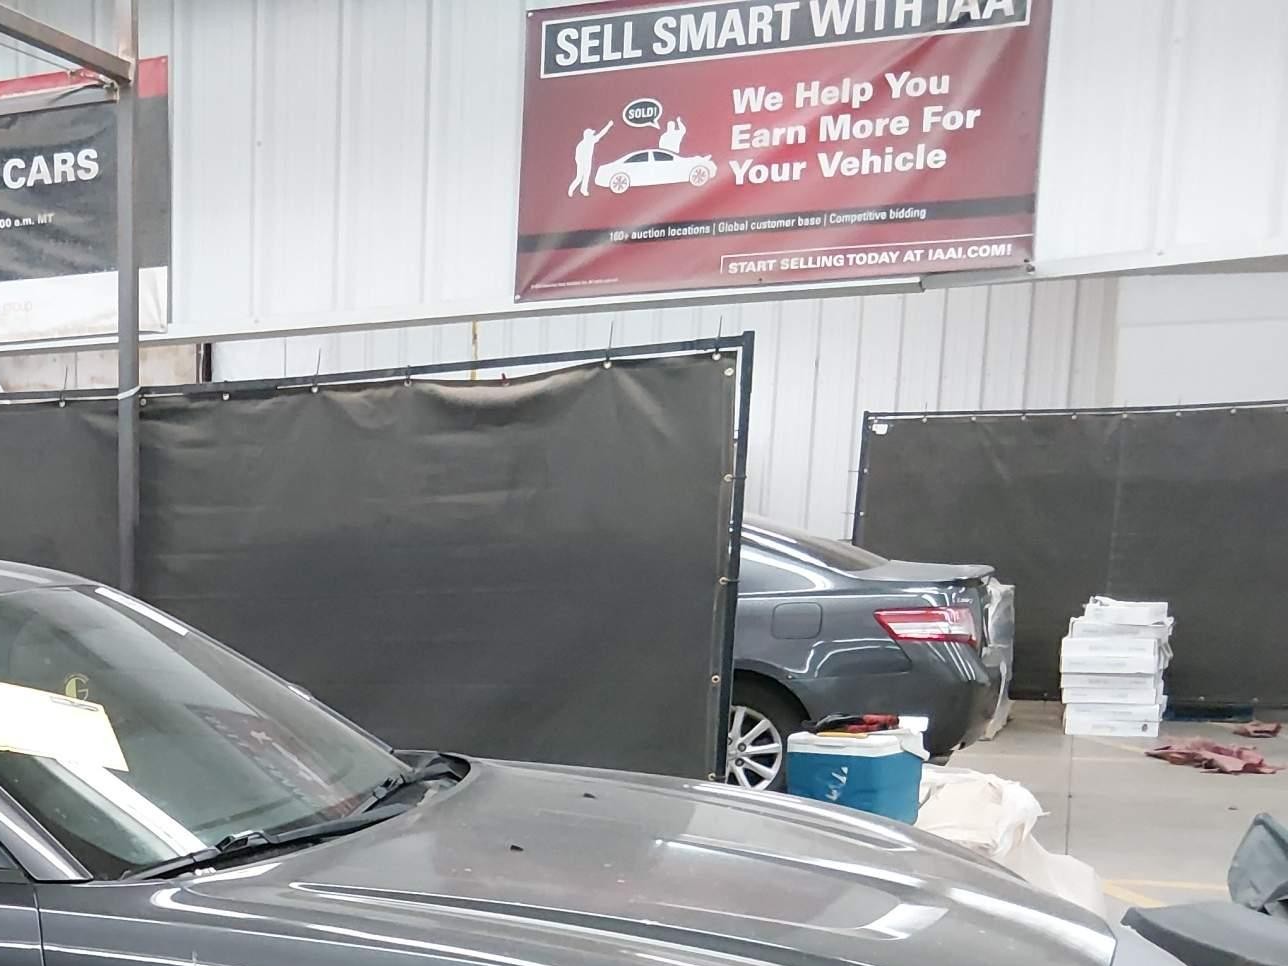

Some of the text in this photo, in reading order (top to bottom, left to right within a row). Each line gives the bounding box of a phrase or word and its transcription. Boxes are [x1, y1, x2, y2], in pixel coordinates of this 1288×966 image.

[555, 21, 642, 66] SELL
[652, 4, 800, 55] SMART
[809, 0, 922, 37] WITH
[628, 106, 658, 120] SOLD!
[732, 71, 950, 114] We Help You
[731, 106, 981, 150] Earn More For
[2, 148, 100, 190] CARS
[729, 144, 947, 185] Your Vehicle
[631, 226, 665, 240] auction
[668, 222, 710, 238] locations
[718, 220, 749, 233] Global
[751, 217, 796, 230] customer
[797, 215, 821, 226] base
[829, 209, 887, 225] Competitive
[889, 206, 927, 220] bidding
[728, 243, 1013, 274] START SELLING TODAY AT IAAI.COM!
